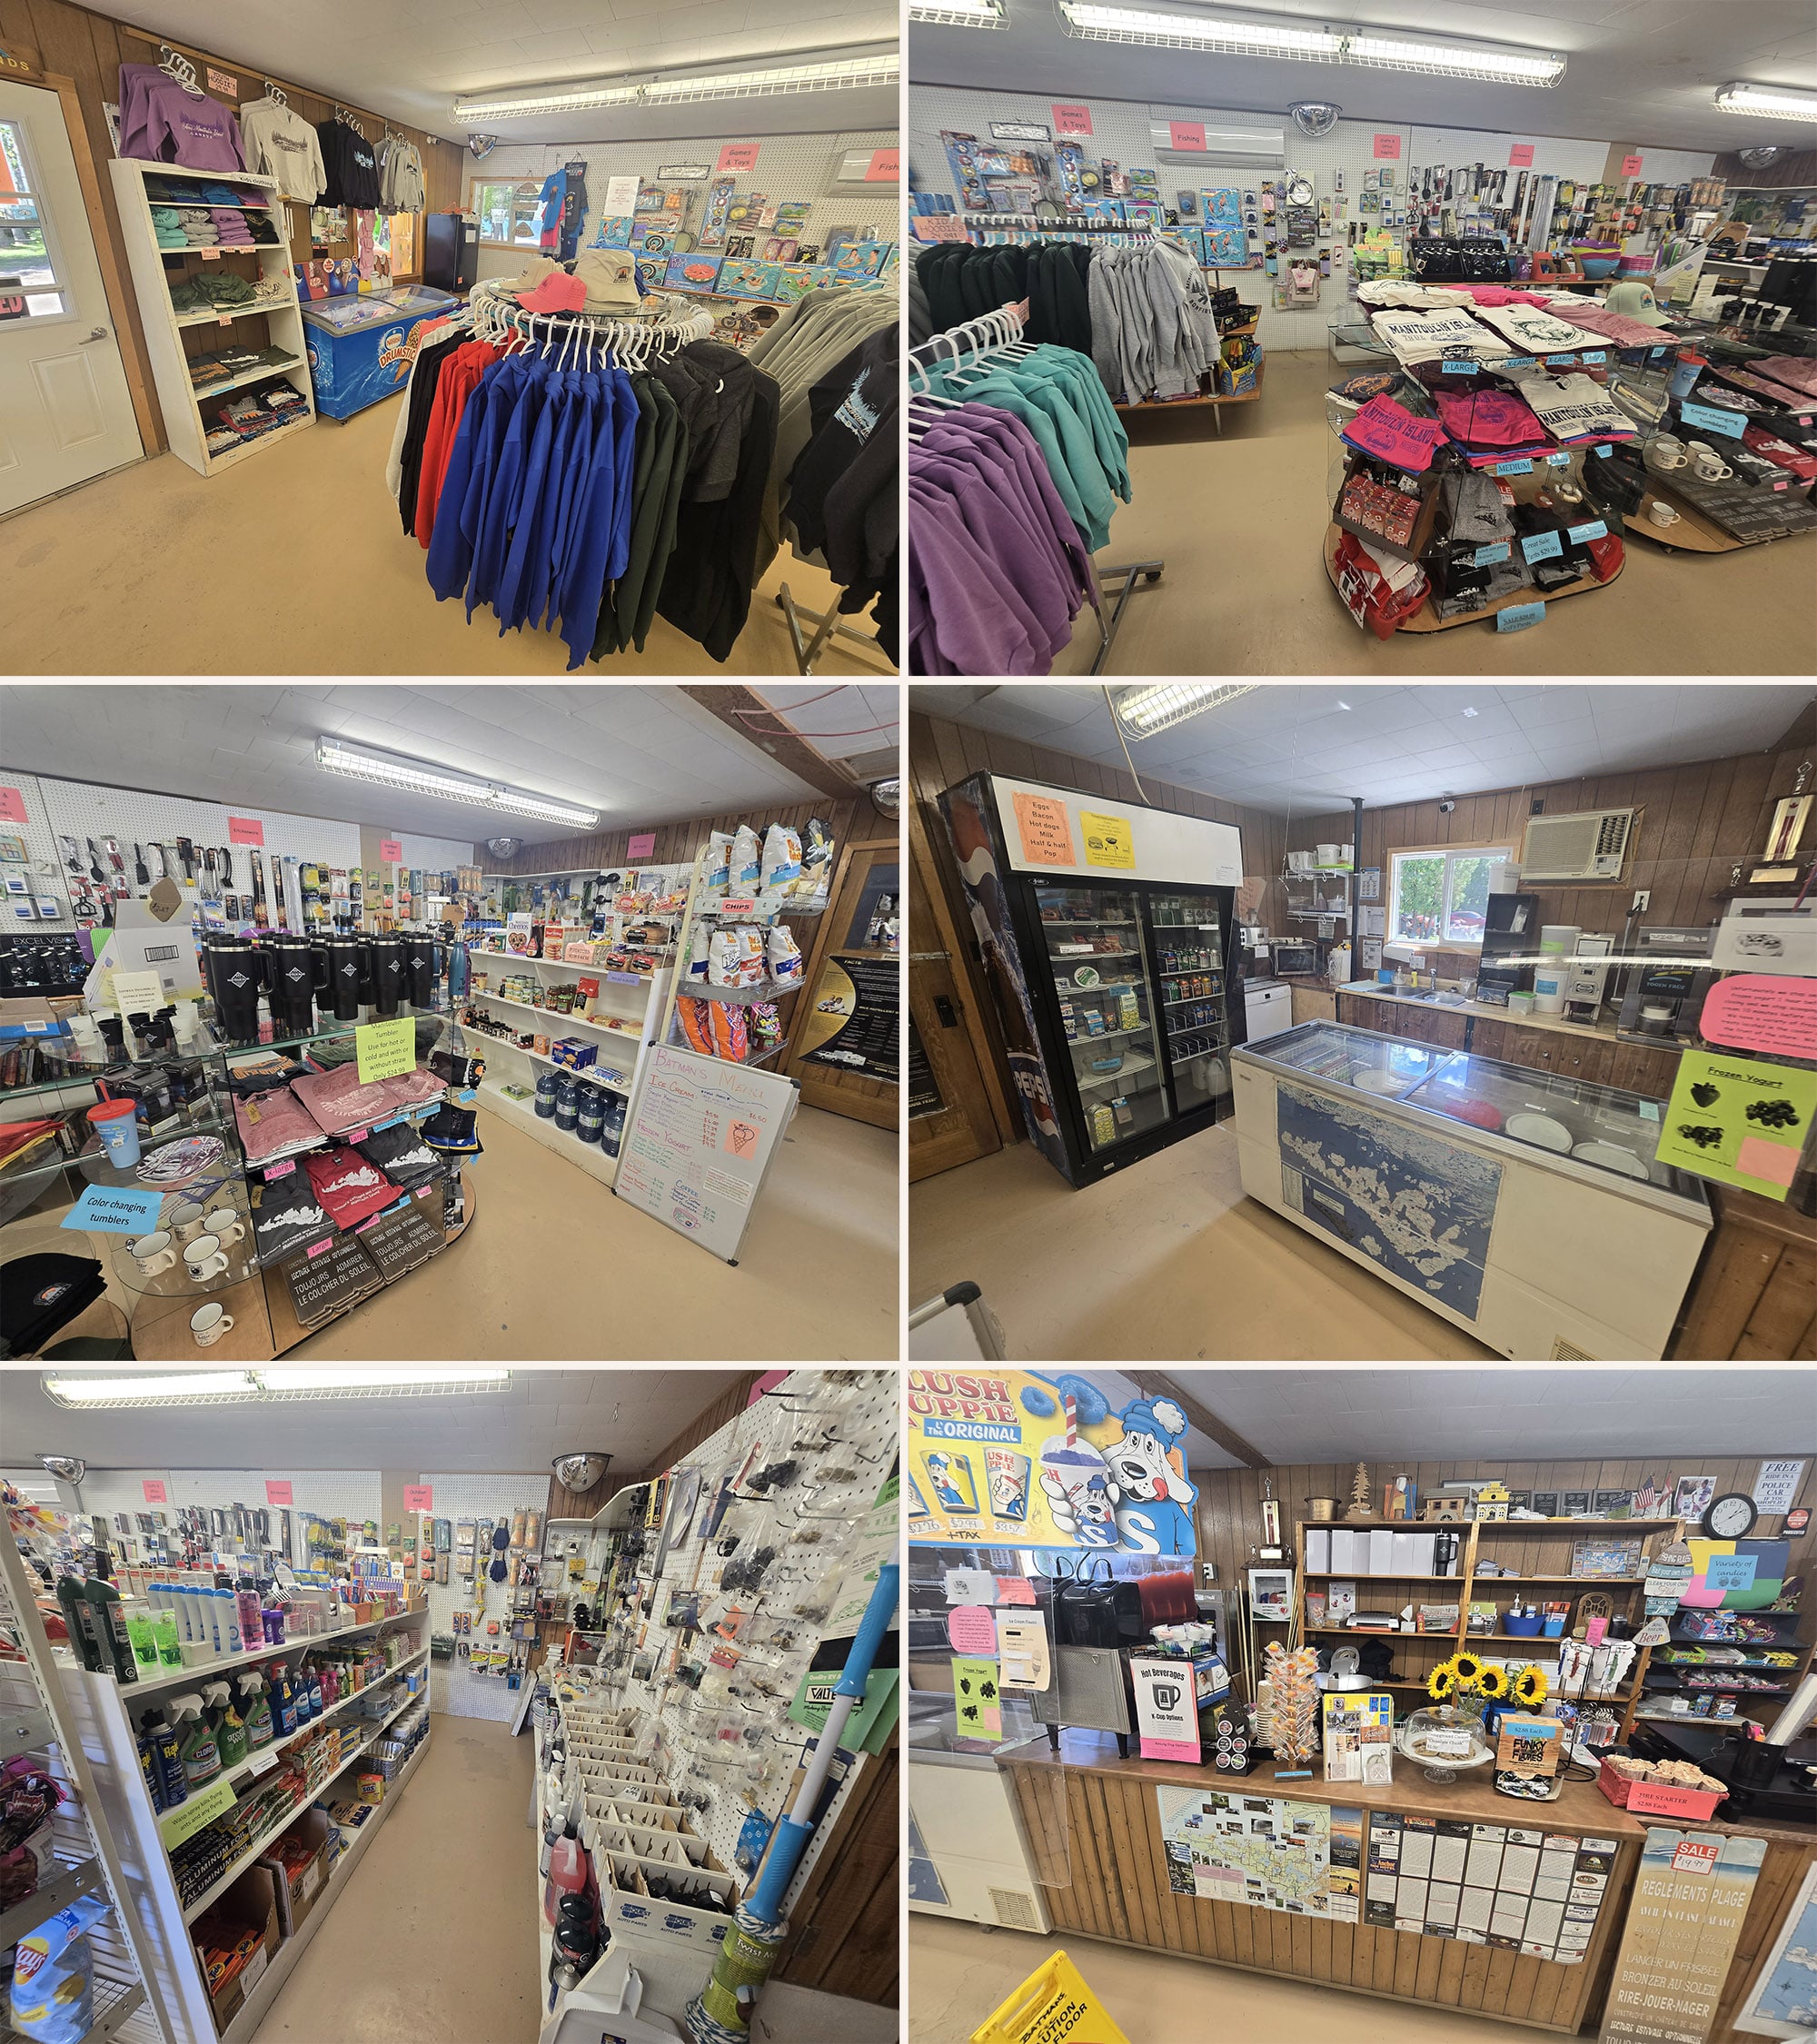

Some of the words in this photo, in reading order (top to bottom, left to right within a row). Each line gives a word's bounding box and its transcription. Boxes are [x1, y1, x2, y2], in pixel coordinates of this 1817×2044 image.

[1070, 121, 1087, 129] Toys
[1177, 134, 1200, 144] Fishing
[1389, 320, 1450, 335] MANITOULIN
[1504, 357, 1536, 367] X-LARGE
[1546, 354, 1575, 364] X-LARGE
[1443, 363, 1476, 373] X-LARGE
[1539, 405, 1594, 425] MANITOULIN
[1691, 409, 1708, 418] Color
[1709, 413, 1739, 426] changing
[1700, 418, 1728, 431] tumblers
[1402, 423, 1436, 444] ISLAND
[1498, 462, 1532, 472] MEDIUM
[1504, 617, 1519, 626] SALE
[1032, 801, 1050, 810] Eggs
[1032, 811, 1054, 820] Bacon
[1044, 822, 1060, 830] dogs
[1044, 849, 1057, 858] Pop
[508, 923, 530, 931] Cheerios
[13, 938, 45, 946] EXCEL
[45, 937, 78, 946] VISION
[376, 1029, 399, 1038] Tumbler
[365, 1054, 377, 1062] cold
[369, 1061, 392, 1071] without
[392, 1057, 406, 1066] straw
[653, 1048, 708, 1080] BATMAN'S
[373, 1072, 386, 1081] Only
[387, 1067, 406, 1077] $24.99
[649, 1074, 667, 1088] ICE
[1707, 1067, 1742, 1079] Frozen
[1746, 1074, 1784, 1086] Yogurt
[1012, 1070, 1050, 1106] PEPSI
[748, 1112, 768, 1124] $6.50
[637, 1118, 660, 1138] FROZEN
[350, 1131, 368, 1144] Large
[266, 1161, 294, 1177] X-large
[367, 1189, 381, 1199] Island
[86, 1197, 109, 1207] Color
[110, 1200, 147, 1215] changing
[90, 1214, 130, 1225] tumblers
[408, 1222, 431, 1239] ADMIRER
[283, 1235, 306, 1251] Manitoulin
[306, 1228, 320, 1241] Island
[312, 1239, 330, 1254] Large
[381, 1255, 390, 1266] LE
[413, 1238, 422, 1249] DU
[422, 1230, 439, 1244] SOLEIL
[291, 1265, 311, 1281] LECTURE
[312, 1255, 332, 1270] ESTIVALE
[332, 1242, 358, 1259] OPTIONNELLE
[336, 1253, 364, 1274] ADMIRER
[299, 1294, 309, 1307] LE
[340, 1274, 349, 1284] DU
[349, 1264, 371, 1279] SOLEIL
[927, 1426, 944, 1436] The
[943, 1422, 1019, 1443] ORIGINAL
[1765, 1463, 1800, 1473] FREE
[950, 1518, 978, 1529] $2.99
[995, 1521, 1020, 1533] $3.57
[1677, 1554, 1692, 1563] RULES
[1715, 1560, 1743, 1568] Variety
[1639, 1632, 1663, 1643] Beer
[809, 1672, 827, 1682] Quality
[1140, 1668, 1152, 1678] Hot
[1152, 1668, 1186, 1681] Beverages
[1166, 1713, 1184, 1722] Options
[1513, 1739, 1547, 1751] FUNKY
[195, 1746, 215, 1759] CLOROX
[1638, 1792, 1654, 1801] FIRE
[1654, 1794, 1688, 1805] STARTER
[171, 1812, 187, 1826] Wasp
[186, 1803, 201, 1818] spray
[200, 1796, 211, 1808] kills
[210, 1789, 223, 1801] flying
[1653, 1802, 1668, 1811] Each
[180, 1821, 192, 1831] ants
[191, 1815, 202, 1825] and
[201, 1809, 211, 1820] any
[210, 1799, 223, 1811] flying
[194, 1818, 208, 1831] insect
[207, 1811, 218, 1822] too
[1678, 1843, 1717, 1859] SALE
[182, 1847, 230, 1890] ALUMINUM
[230, 1831, 248, 1847] FOIL
[1677, 1856, 1705, 1868] $19.99
[186, 1858, 233, 1903] ALUMINUM
[233, 1843, 251, 1860] FOIL
[1710, 1889, 1746, 1908] PLAGE
[617, 1917, 631, 1925] AUTO
[631, 1920, 648, 1928] PARTS
[663, 1915, 698, 1929] CARQUEST
[660, 1927, 675, 1935] AUTO
[675, 1930, 693, 1939] PARTS
[238, 1939, 250, 1953] Tide
[705, 1938, 721, 1946] AUTO
[736, 1938, 762, 1958] Twist
[210, 1963, 222, 1979] Tide
[1625, 1953, 1664, 1968] LANCER
[1664, 1960, 1680, 1970] UN
[1680, 1961, 1722, 1978] FRISBEE
[1622, 1970, 1667, 1989] BRONZER
[1667, 1978, 1683, 1990] AU
[1683, 1980, 1717, 1997] SOLEIL
[1617, 1989, 1711, 2018] RIRE-JOUER-NAGER
[1036, 2001, 1077, 2044] UTION
[1052, 2002, 1087, 2044] FLOOR
[1610, 2020, 1635, 2033] LECTURE
[1635, 2025, 1663, 2039] ESTIVALE
[1664, 2030, 1703, 2044] OPTIONNELLE
